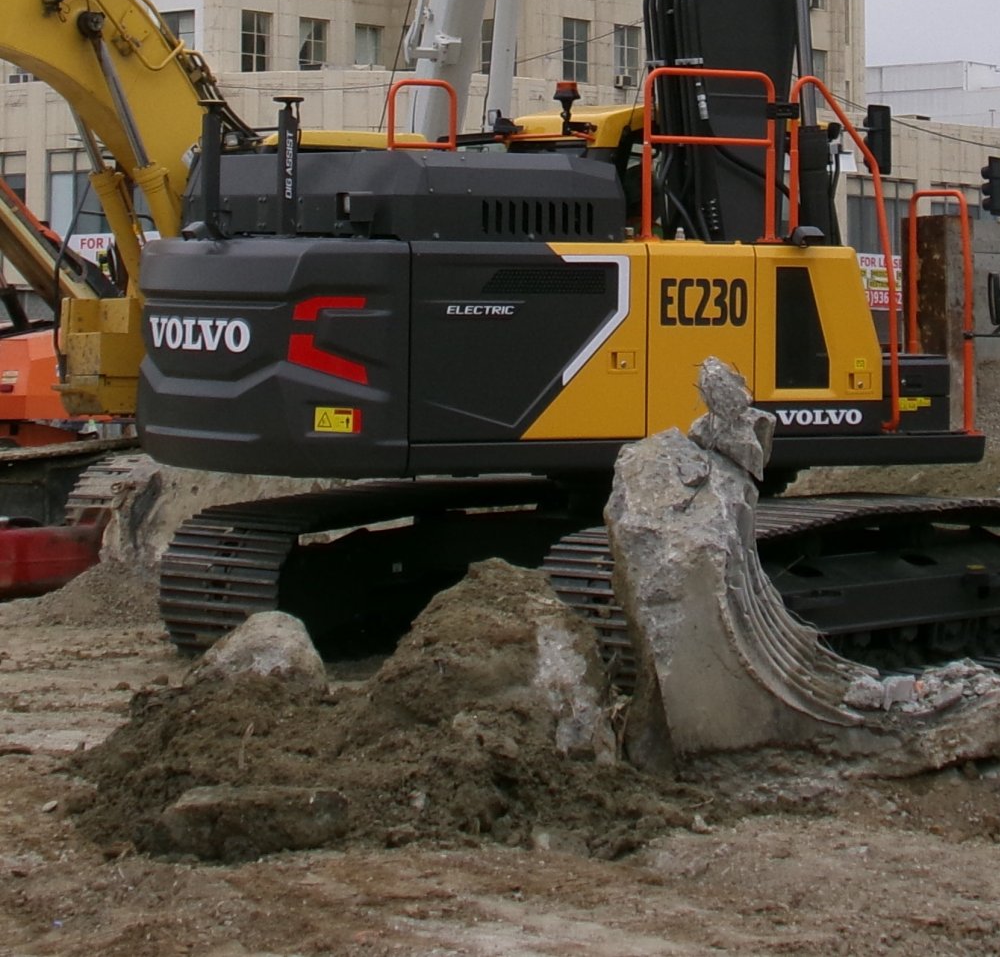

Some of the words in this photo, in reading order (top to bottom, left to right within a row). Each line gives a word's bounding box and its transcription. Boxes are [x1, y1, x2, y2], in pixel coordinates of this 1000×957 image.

[285, 129, 294, 176] ASSIST
[284, 177, 293, 200] DIG
[80, 237, 104, 250] FOR
[860, 256, 877, 268] FOR
[446, 305, 516, 316] ELECTRIC
[660, 277, 748, 327] EC230
[149, 315, 251, 353] VOLVO
[775, 408, 863, 426] VOLVO
